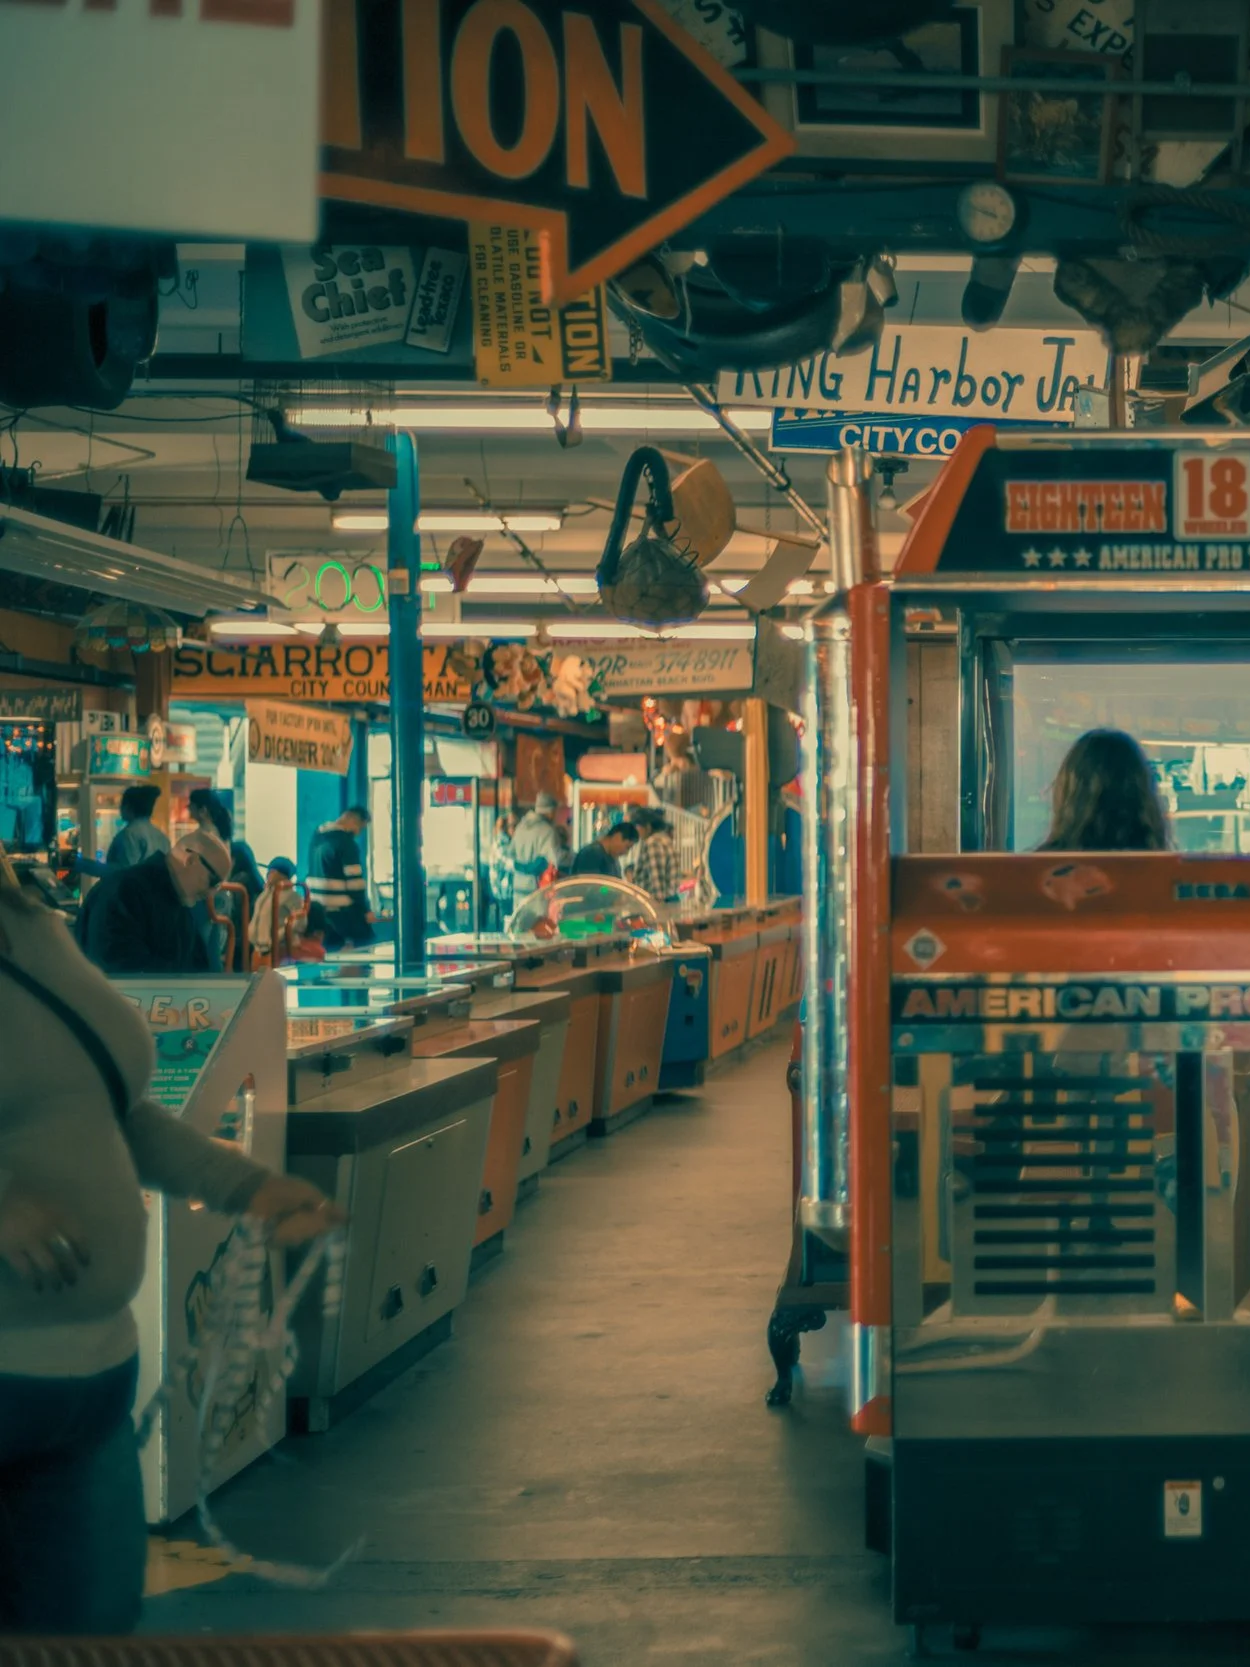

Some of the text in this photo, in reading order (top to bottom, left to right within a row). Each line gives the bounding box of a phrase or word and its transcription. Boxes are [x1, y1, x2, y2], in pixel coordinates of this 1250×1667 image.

[310, 245, 386, 283] Sea
[301, 268, 407, 323] Chief
[474, 243, 493, 348] FOR CLEANING
[507, 228, 527, 360] USE GASOLINE OR
[528, 288, 553, 341] NOT
[494, 292, 512, 374] MATERIALS
[838, 424, 908, 452] CITY
[1005, 480, 1167, 533] EIGHTEEN
[1183, 457, 1248, 520] 18
[1098, 544, 1199, 570] AMERICAN
[1204, 545, 1243, 570] PRO
[290, 679, 458, 697] CITY COUNMAN
[467, 707, 490, 728] 30
[901, 984, 1162, 1020] AMERICAN
